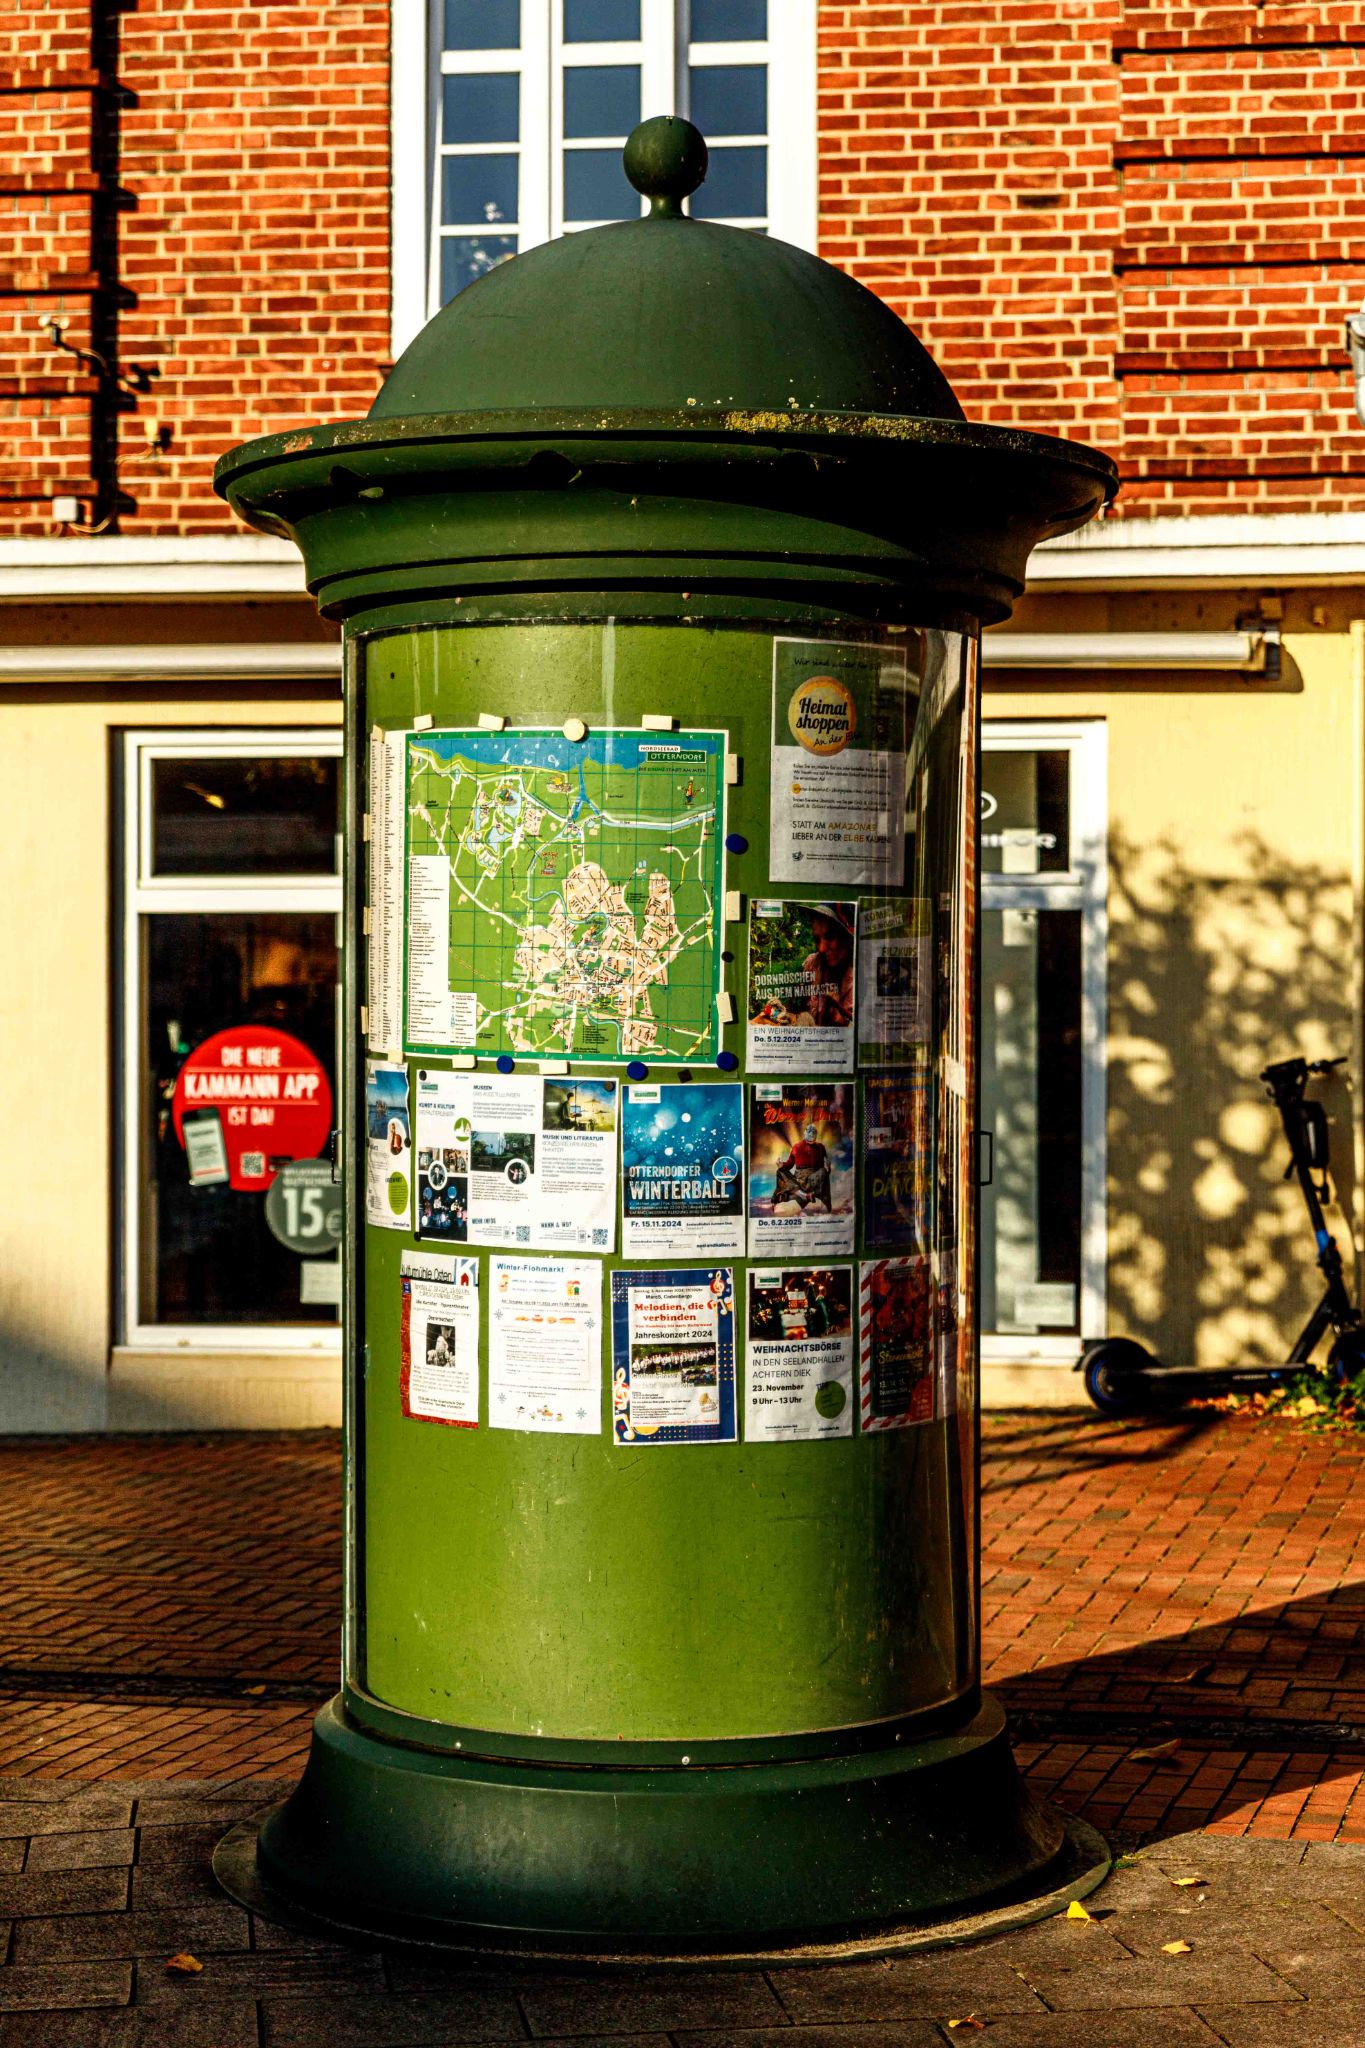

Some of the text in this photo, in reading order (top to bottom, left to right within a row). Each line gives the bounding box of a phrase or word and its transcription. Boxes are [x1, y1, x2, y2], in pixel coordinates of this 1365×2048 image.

[799, 697, 848, 716] Heimat
[795, 715, 850, 735] shoppen
[813, 738, 827, 747] An
[828, 734, 843, 743] der
[650, 752, 703, 761] OTTERNDORF
[792, 820, 812, 829] STATT
[813, 821, 826, 829] AM
[792, 832, 814, 841] LIEBER
[815, 833, 828, 841] AN
[828, 833, 842, 842] DER
[843, 834, 865, 842] ELBE
[754, 970, 817, 987] DORNRÖSCHEN
[755, 982, 840, 1000] AUS DEM NÄHKASTEN
[753, 1027, 841, 1036] EIN WEIHNACHTSTHEATER
[221, 1047, 282, 1067] DIE NEUE
[184, 1073, 320, 1100] KAMMANN APP
[228, 1106, 275, 1126] IST DA!
[629, 1165, 702, 1178] OTTERNDORFER
[629, 1179, 730, 1200] WINTERBALL
[641, 1220, 683, 1228] 15.11.2024
[496, 1263, 565, 1273] Winter-Flohmarkt
[433, 1268, 453, 1281] Osten
[634, 1302, 704, 1312] Melodien, die
[643, 1313, 697, 1321] verbinden
[634, 1330, 713, 1339] Jahreskonzert 2024
[752, 1341, 842, 1354] WEIHNACHTSBÖRSE
[763, 1358, 781, 1366] DEN
[782, 1355, 845, 1366] SEELANDHALLEN
[752, 1369, 812, 1379] ACHTERN DIEK
[766, 1384, 805, 1392] November
[759, 1397, 773, 1405] Uhr
[789, 1396, 802, 1404] Uhr
